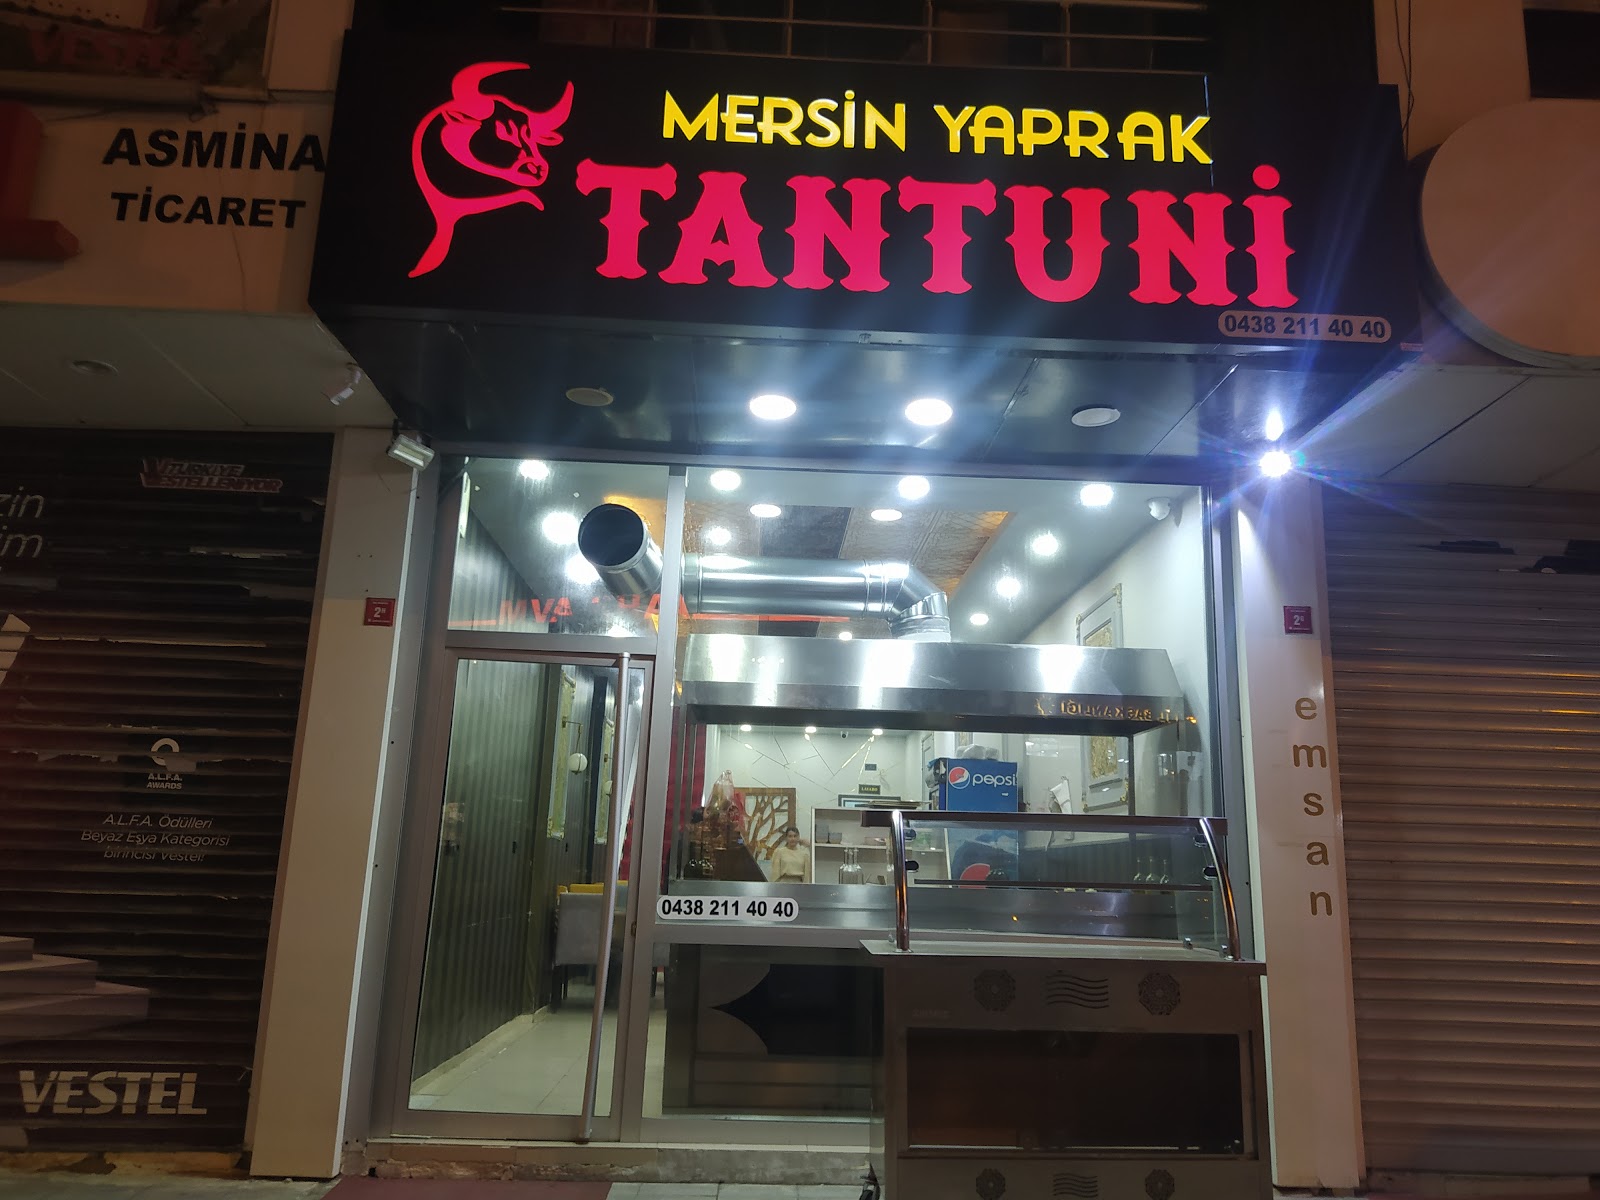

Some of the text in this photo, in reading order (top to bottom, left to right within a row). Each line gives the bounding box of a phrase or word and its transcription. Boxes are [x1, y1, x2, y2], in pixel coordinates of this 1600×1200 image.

[662, 90, 1214, 164] MERSİN YAPRAK
[102, 122, 326, 172] ASMİNA
[111, 186, 306, 228] TİCARET
[576, 158, 1299, 308] TANTUNİ
[1224, 315, 1385, 338] 0438 211 40 40
[146, 781, 182, 790] AWARDS
[972, 773, 1016, 788] pepsi
[158, 813, 214, 830] Ödülleri
[1293, 697, 1333, 916] emsan
[80, 829, 231, 848] Beyaz Eşya Kategorisi
[661, 899, 794, 918] 0438 211 40 40
[19, 1070, 207, 1115] VESTEL
